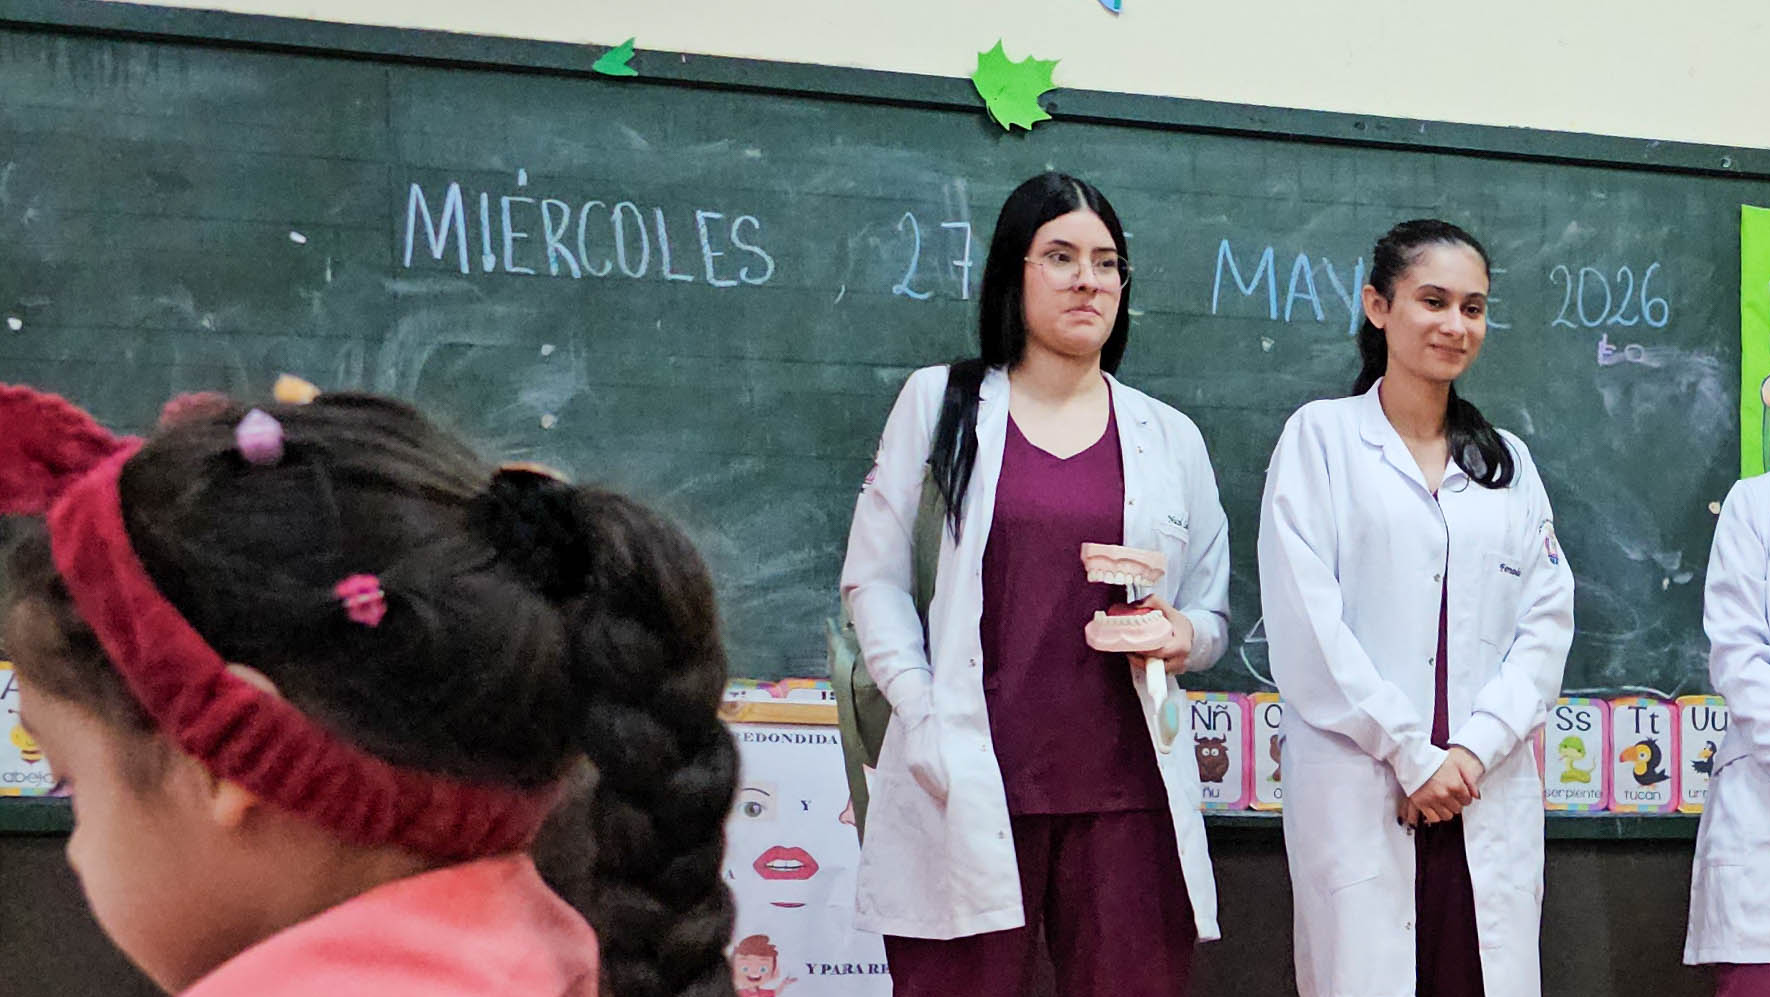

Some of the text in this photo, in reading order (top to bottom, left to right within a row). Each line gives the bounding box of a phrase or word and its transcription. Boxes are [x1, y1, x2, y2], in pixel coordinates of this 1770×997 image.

[404, 168, 775, 288] MIÉRCOLES
[892, 211, 973, 300] 27
[1211, 238, 1364, 336] MAY
[1549, 261, 1670, 329] 2026
[1191, 700, 1232, 732] Ññ
[1264, 703, 1283, 729] O
[1555, 706, 1592, 732] Ss
[1627, 706, 1661, 735] Tt
[1691, 706, 1729, 732] Uu
[735, 731, 839, 745] EDONDIDA
[806, 962, 816, 975] Y
[820, 962, 864, 975] PARA
